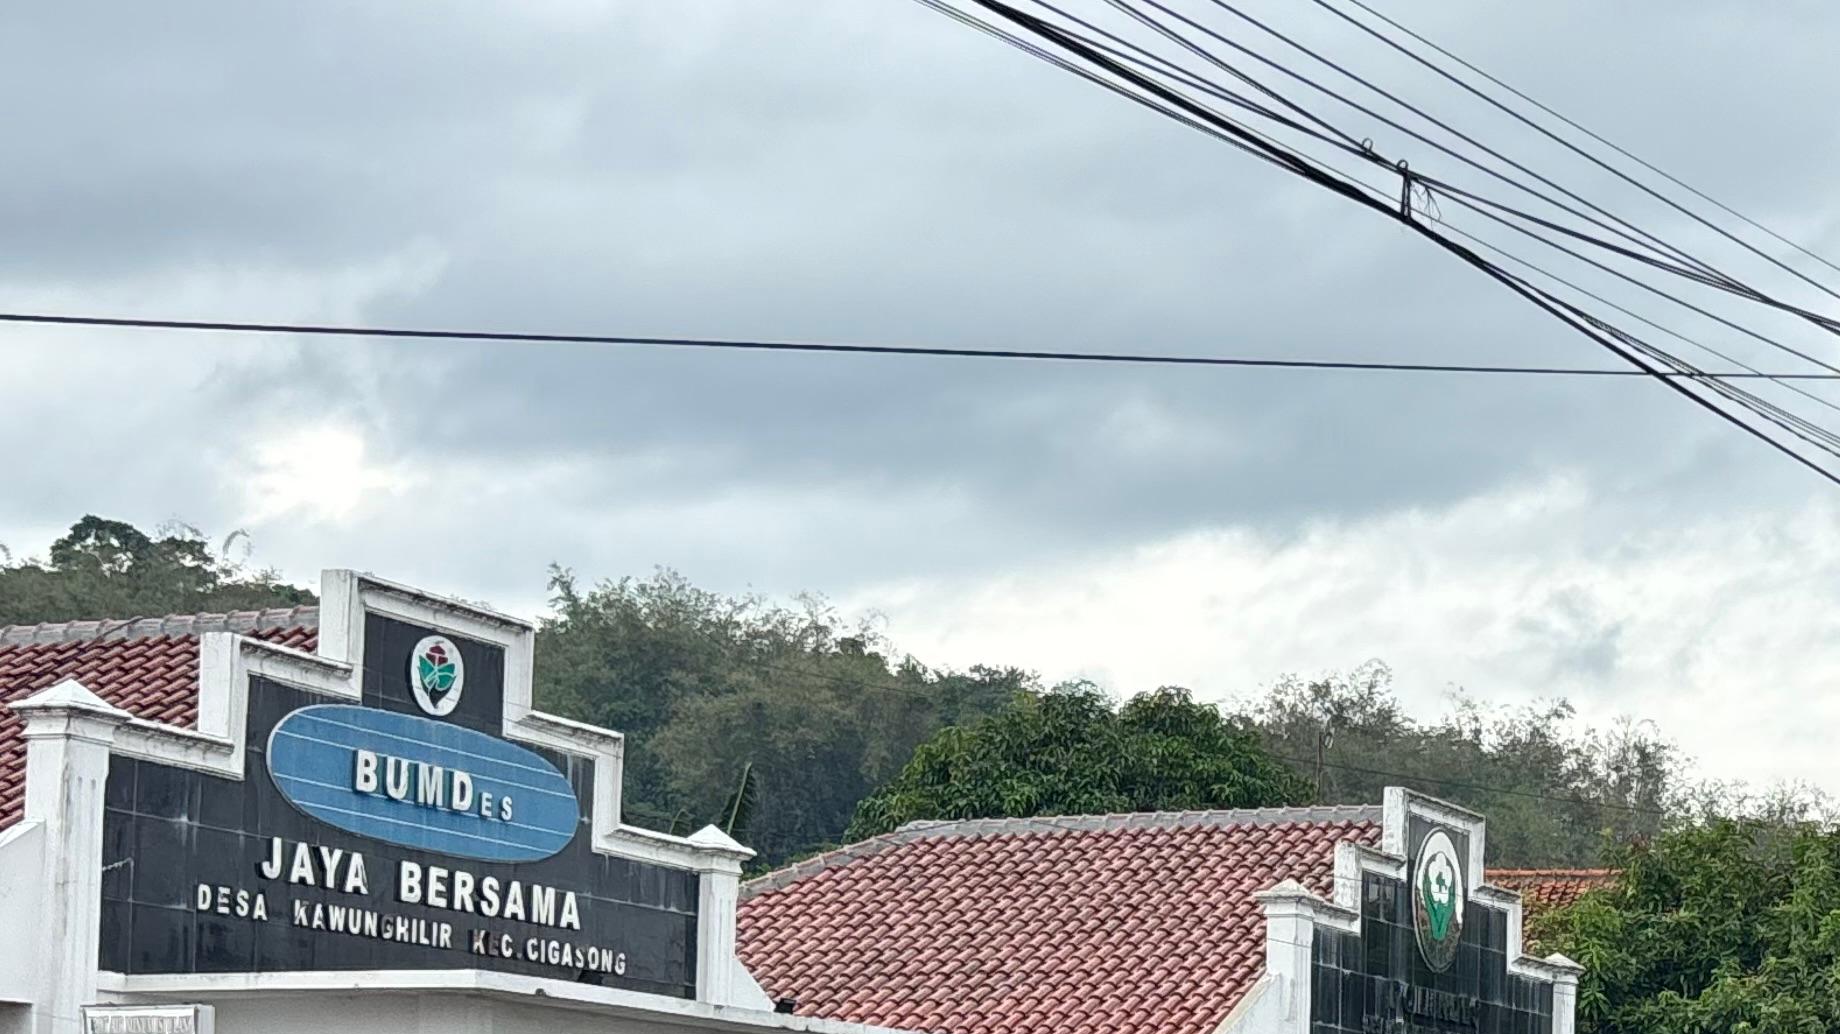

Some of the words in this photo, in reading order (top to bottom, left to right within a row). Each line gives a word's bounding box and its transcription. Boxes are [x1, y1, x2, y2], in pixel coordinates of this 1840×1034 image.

[198, 883, 268, 922] DESA
[261, 837, 369, 895] JAYA
[400, 860, 581, 931] BERSAMA
